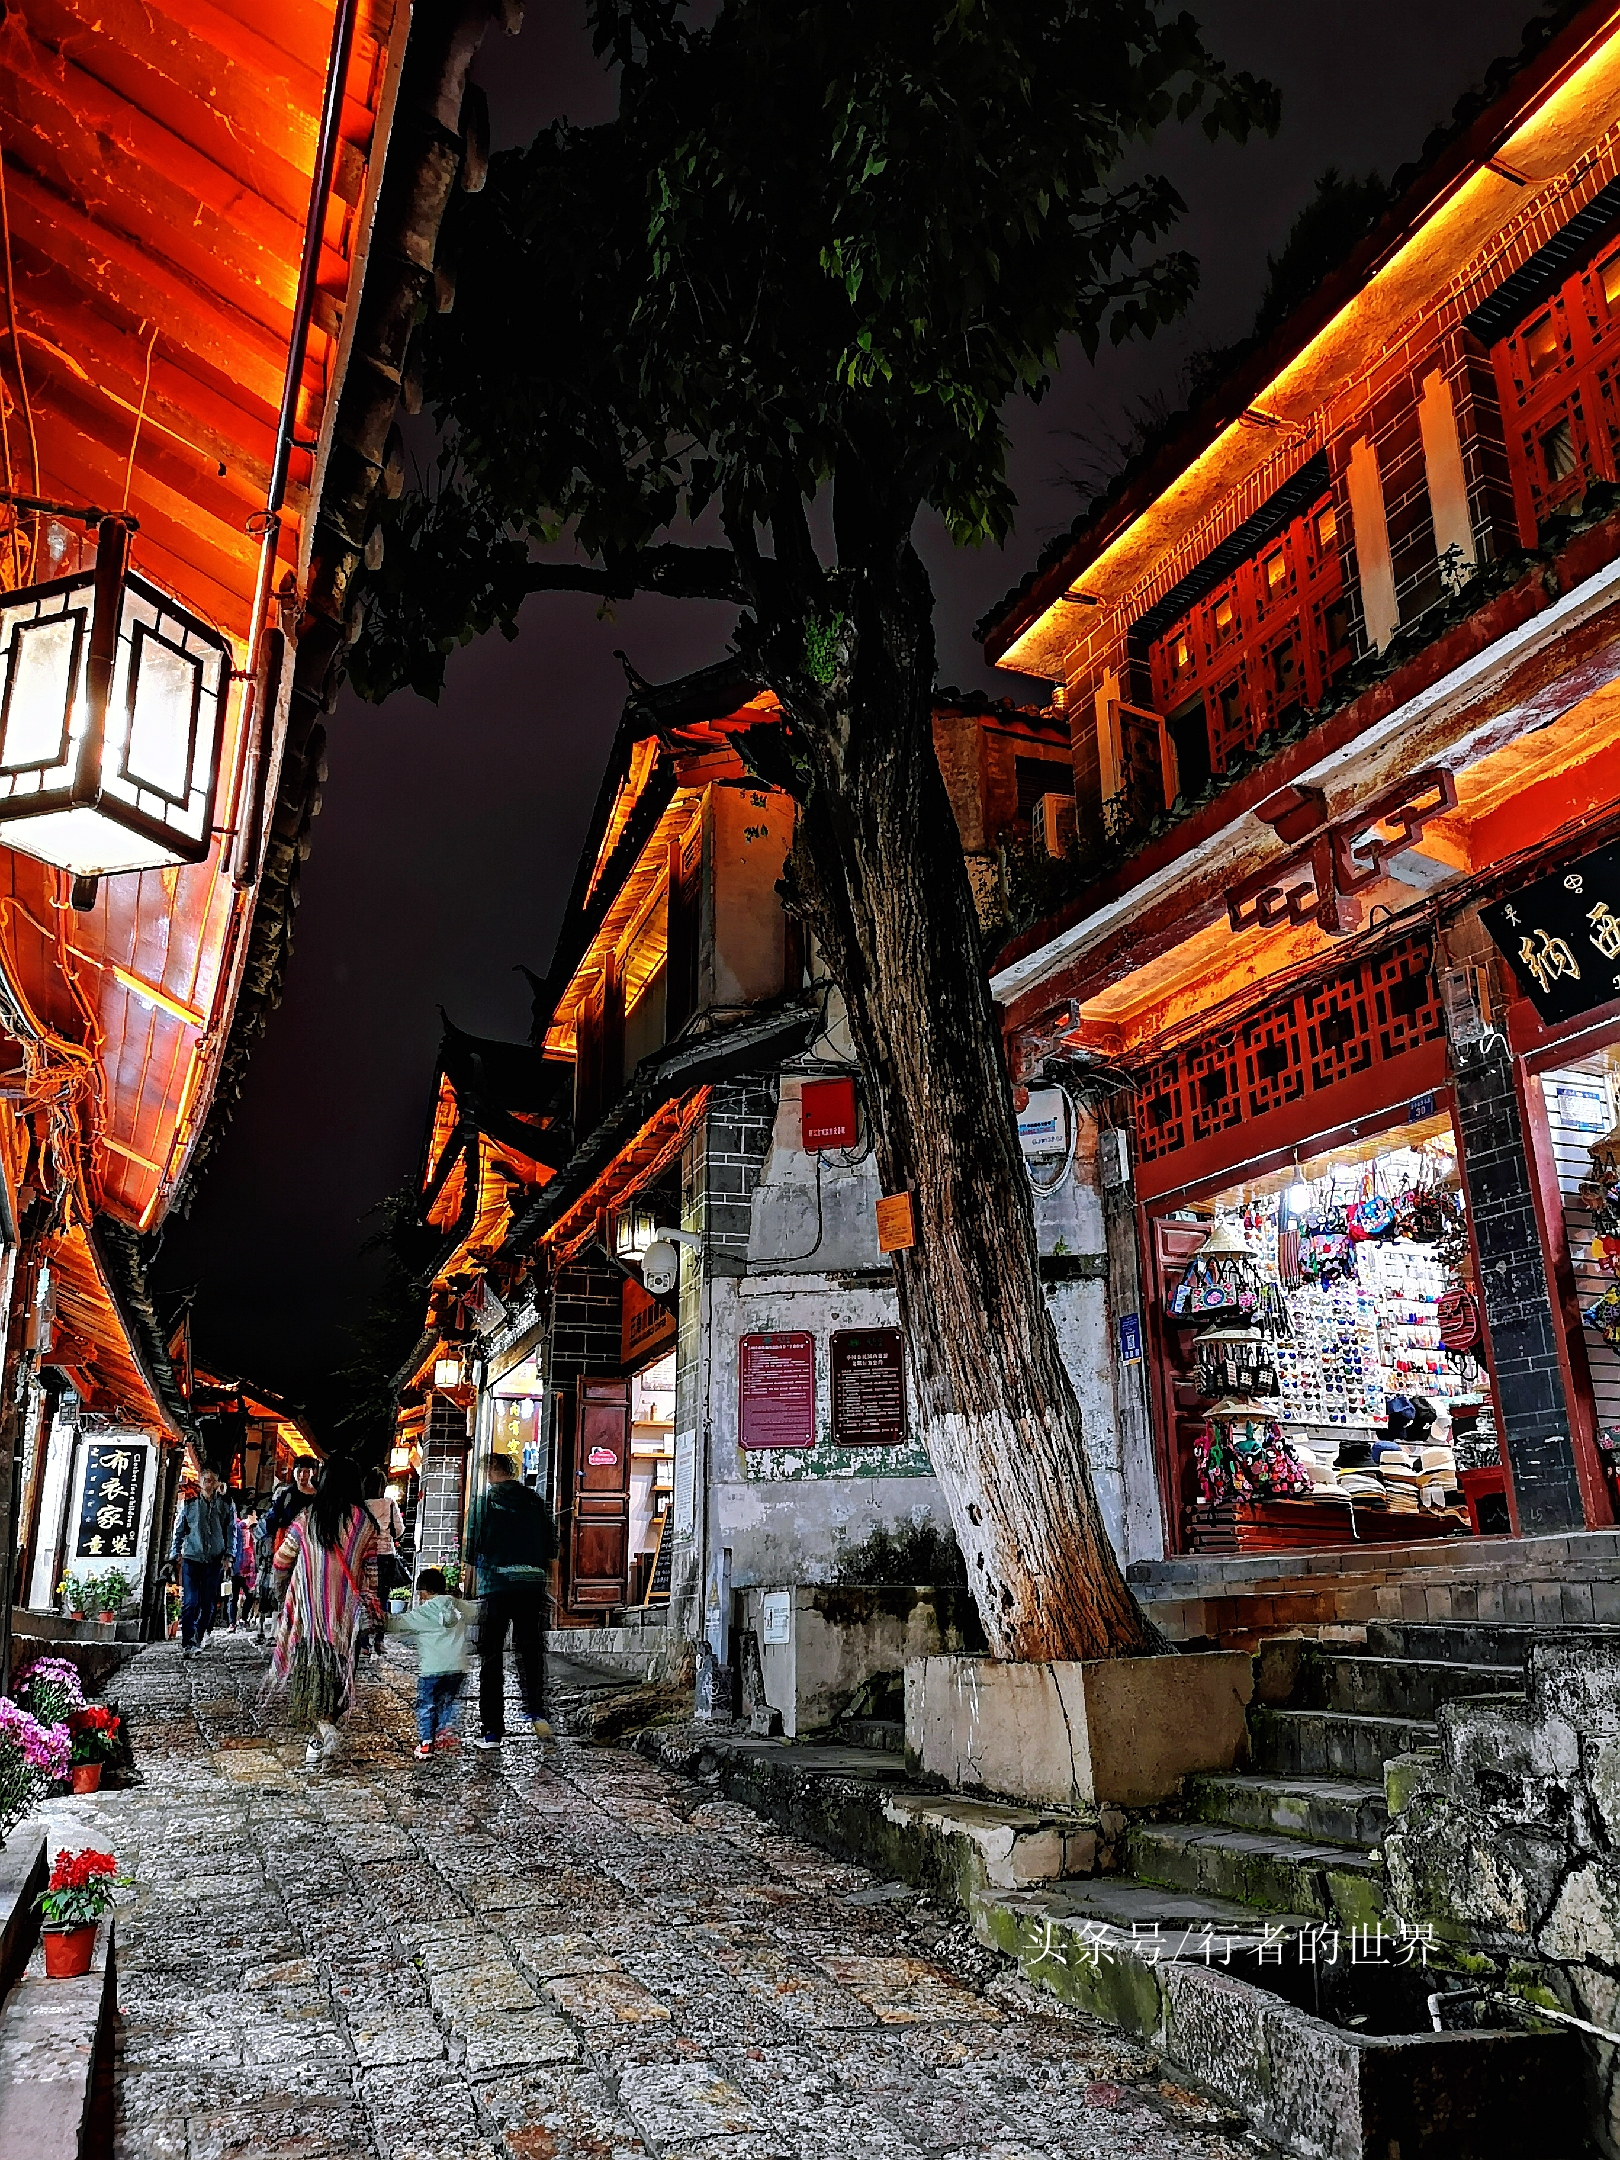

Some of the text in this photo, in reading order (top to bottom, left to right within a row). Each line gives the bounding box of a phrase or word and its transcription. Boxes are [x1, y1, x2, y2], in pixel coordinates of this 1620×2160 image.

[96, 1449, 132, 1529] 布衣家
[82, 1533, 131, 1556] 童装
